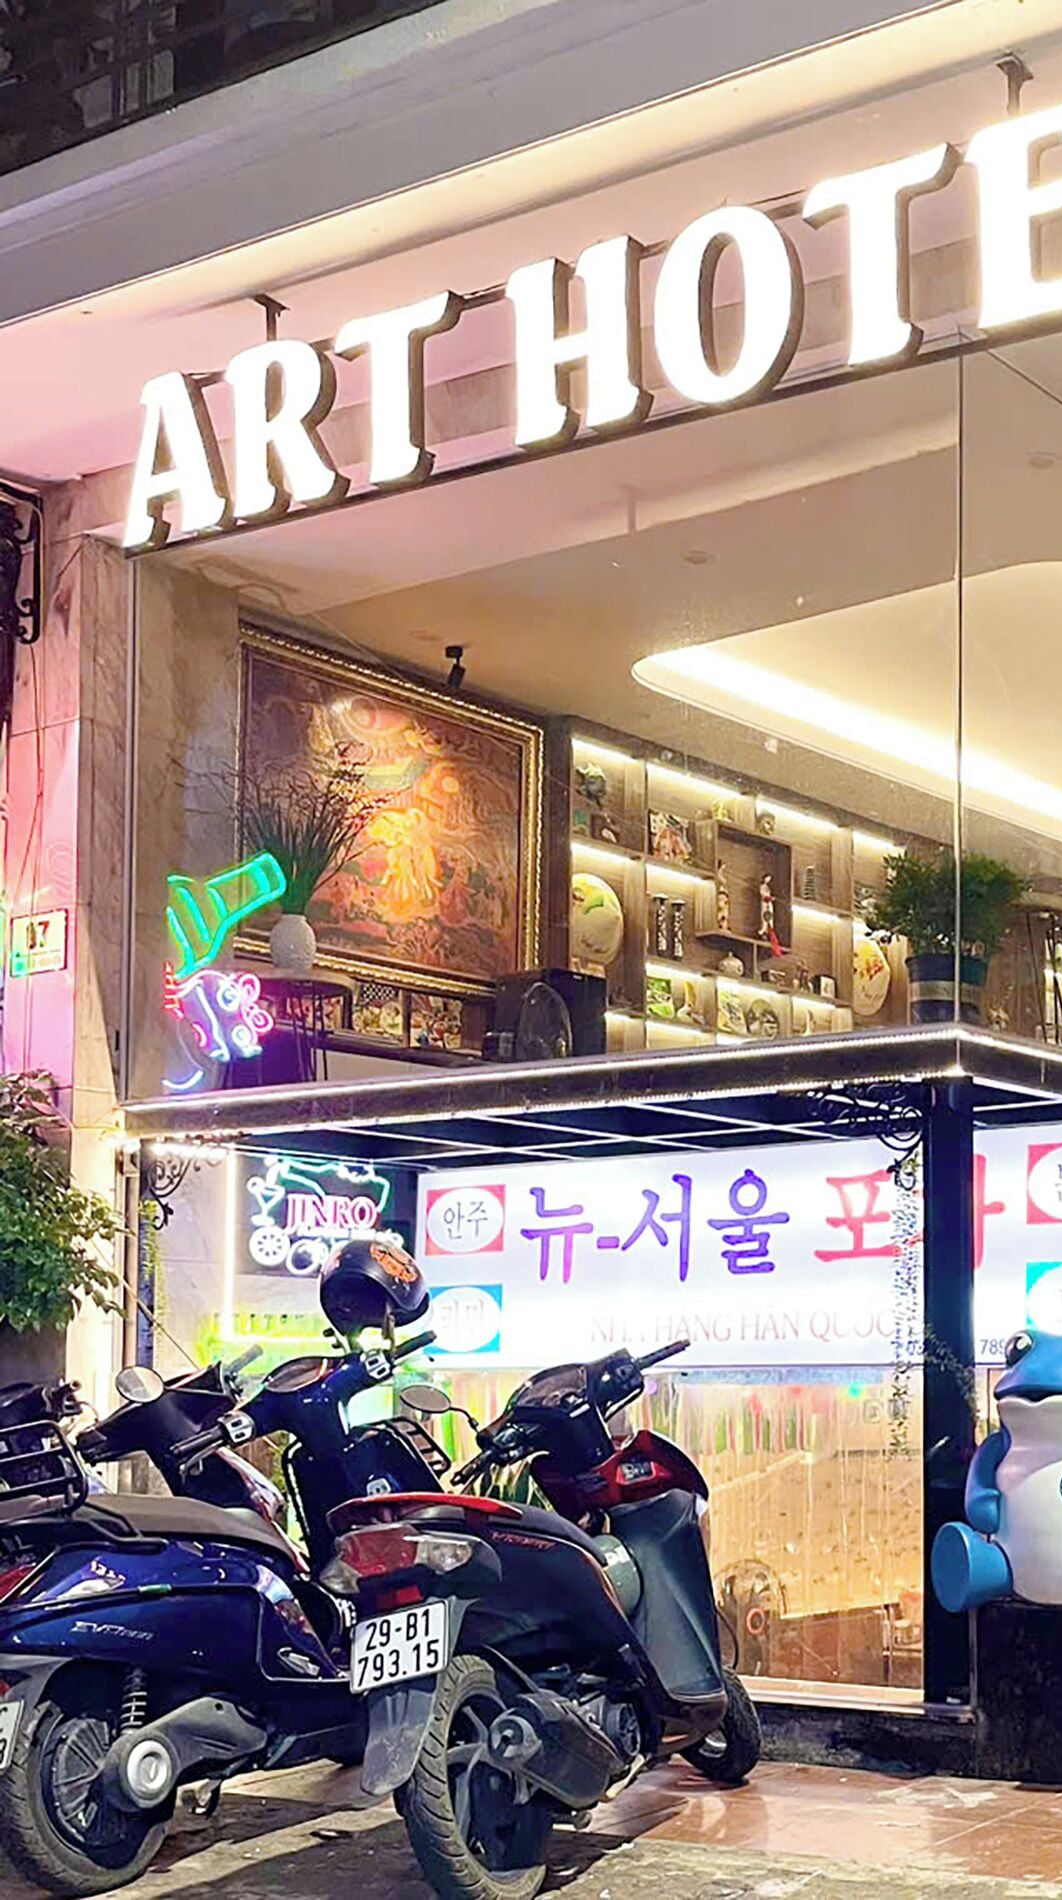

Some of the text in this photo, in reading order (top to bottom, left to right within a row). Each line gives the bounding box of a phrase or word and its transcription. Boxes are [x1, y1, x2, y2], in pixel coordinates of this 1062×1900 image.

[122, 290, 462, 549] ART
[442, 1200, 489, 1240] 안주
[520, 1168, 790, 1284] 뉴-서울
[365, 1608, 430, 1652] 29-B1
[357, 1639, 439, 1688] 793.15
